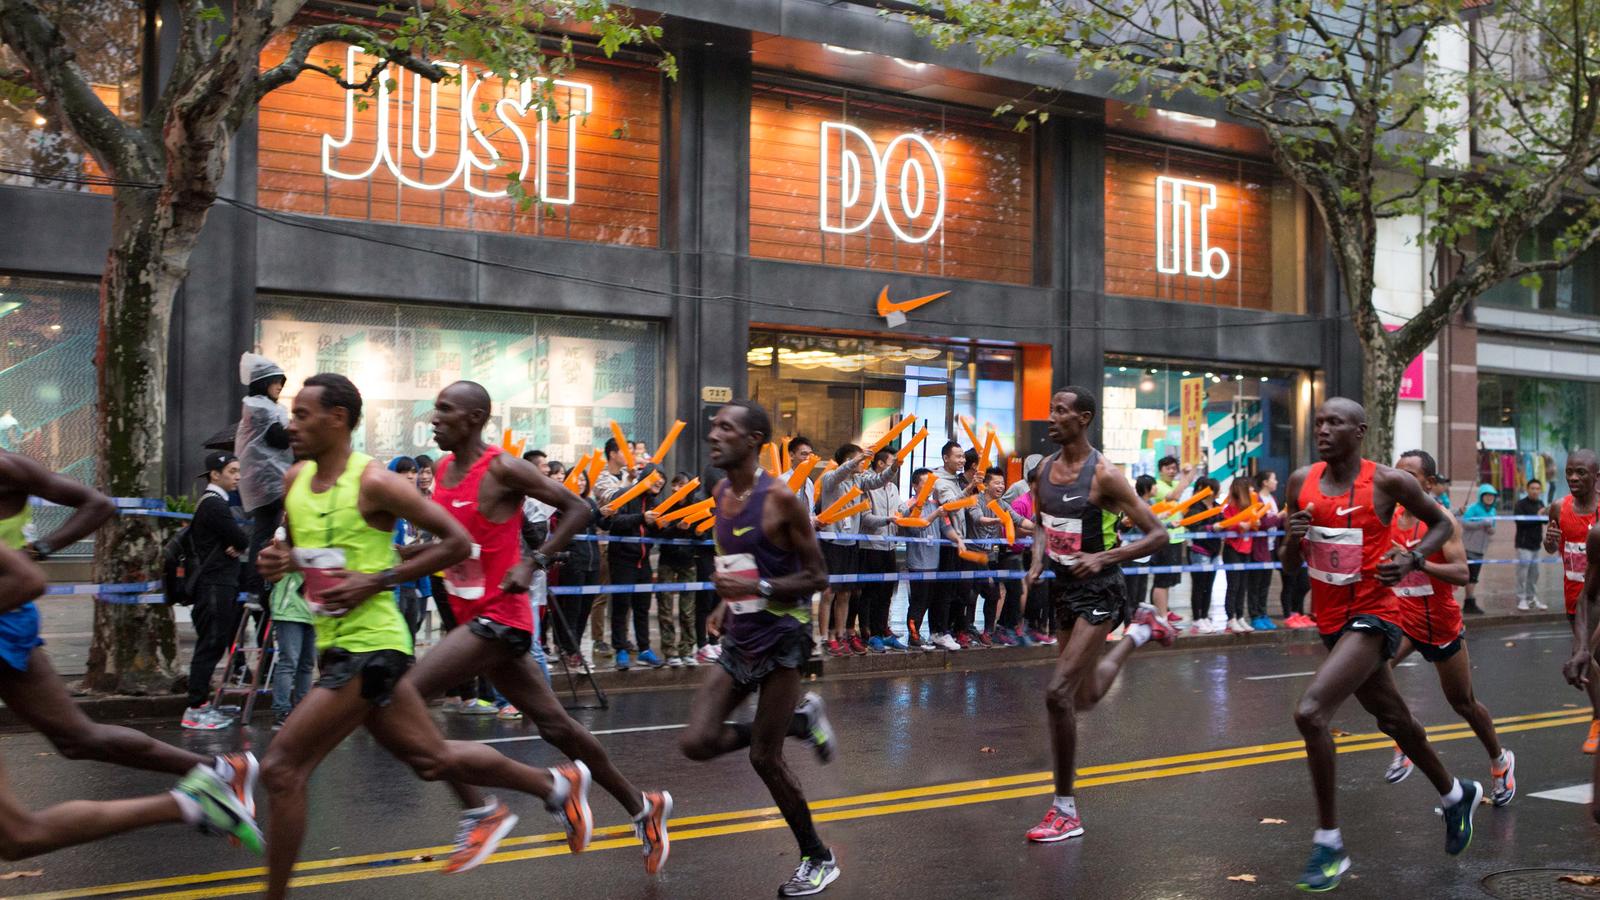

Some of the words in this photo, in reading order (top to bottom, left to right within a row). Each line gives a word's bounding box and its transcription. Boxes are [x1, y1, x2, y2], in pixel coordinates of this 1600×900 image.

[322, 45, 593, 205] JUST
[820, 121, 946, 244] DO
[1156, 175, 1231, 280] IT.
[1330, 550, 1340, 569] 6
